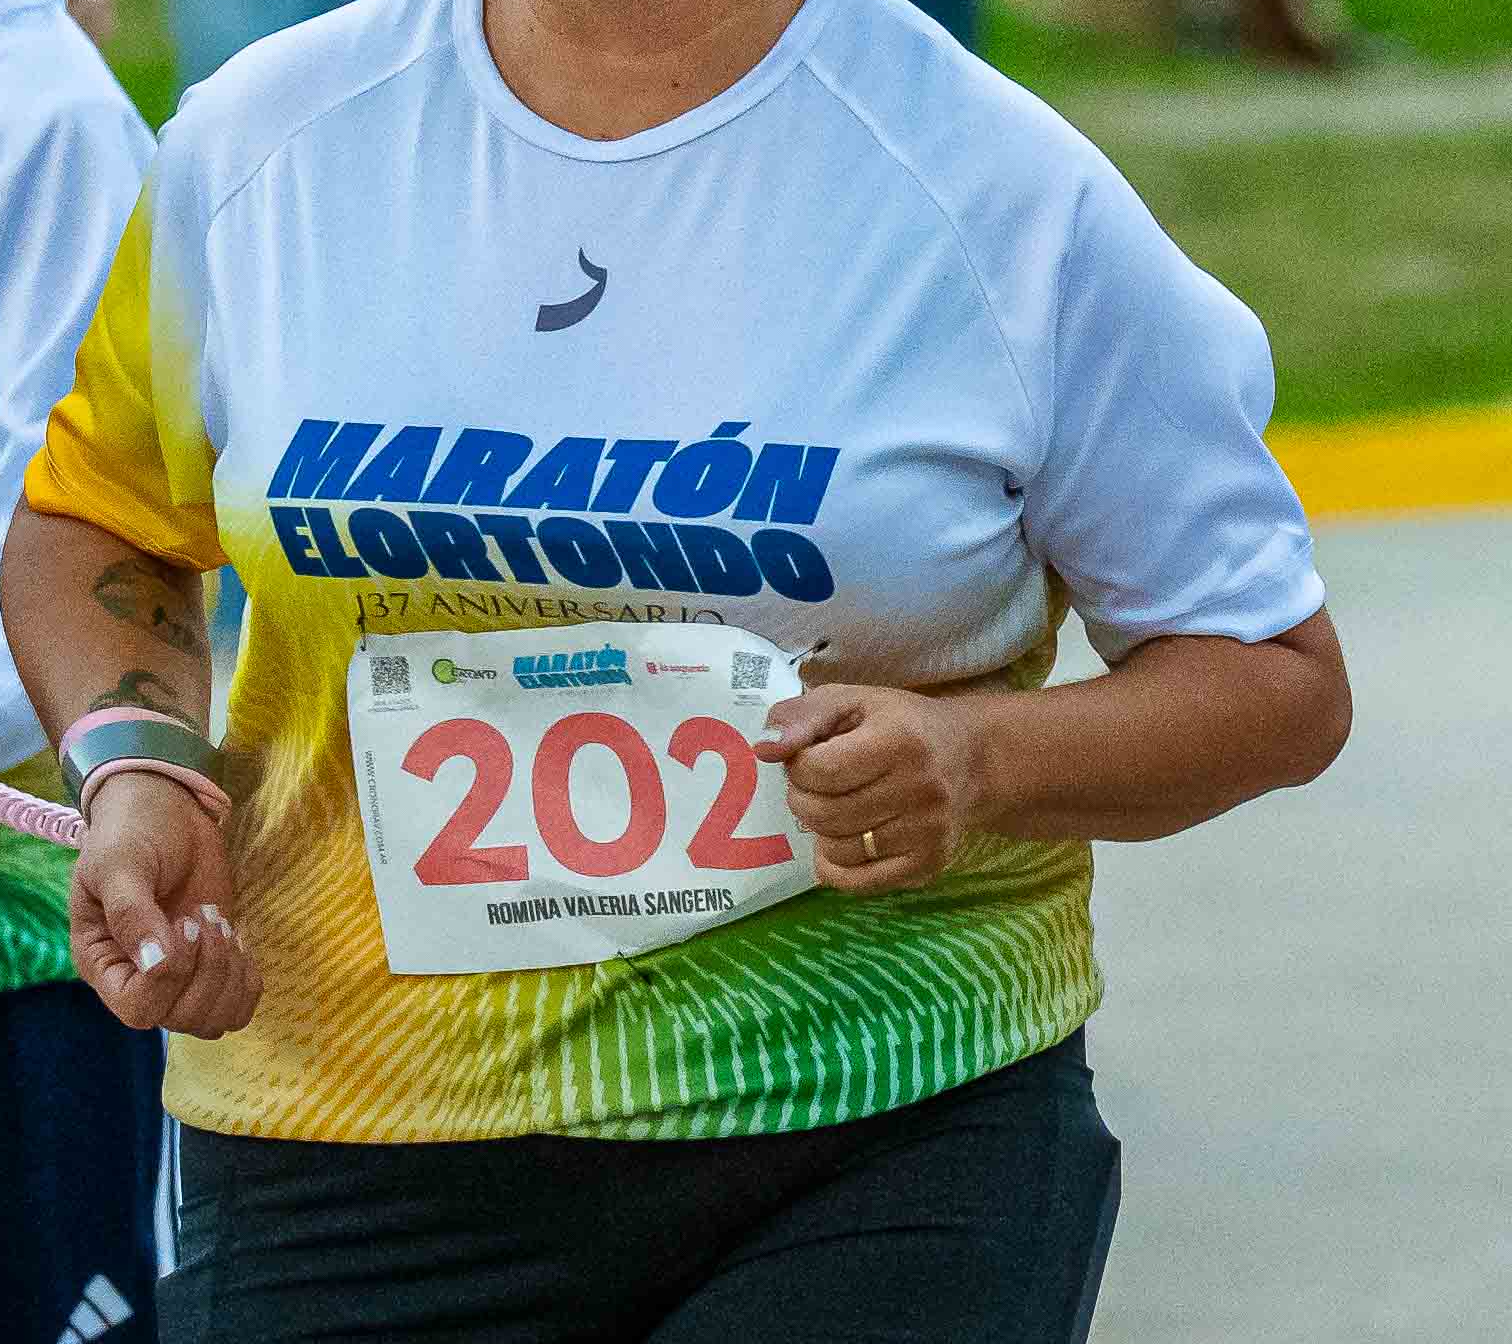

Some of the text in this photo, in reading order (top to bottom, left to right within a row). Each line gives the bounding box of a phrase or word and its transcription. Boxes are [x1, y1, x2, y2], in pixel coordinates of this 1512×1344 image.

[267, 418, 841, 524] MARATÓN
[268, 505, 836, 603] ELORTONDO
[400, 712, 794, 886] 202
[487, 888, 735, 925] ROMINA VALERIA SANGENIS
